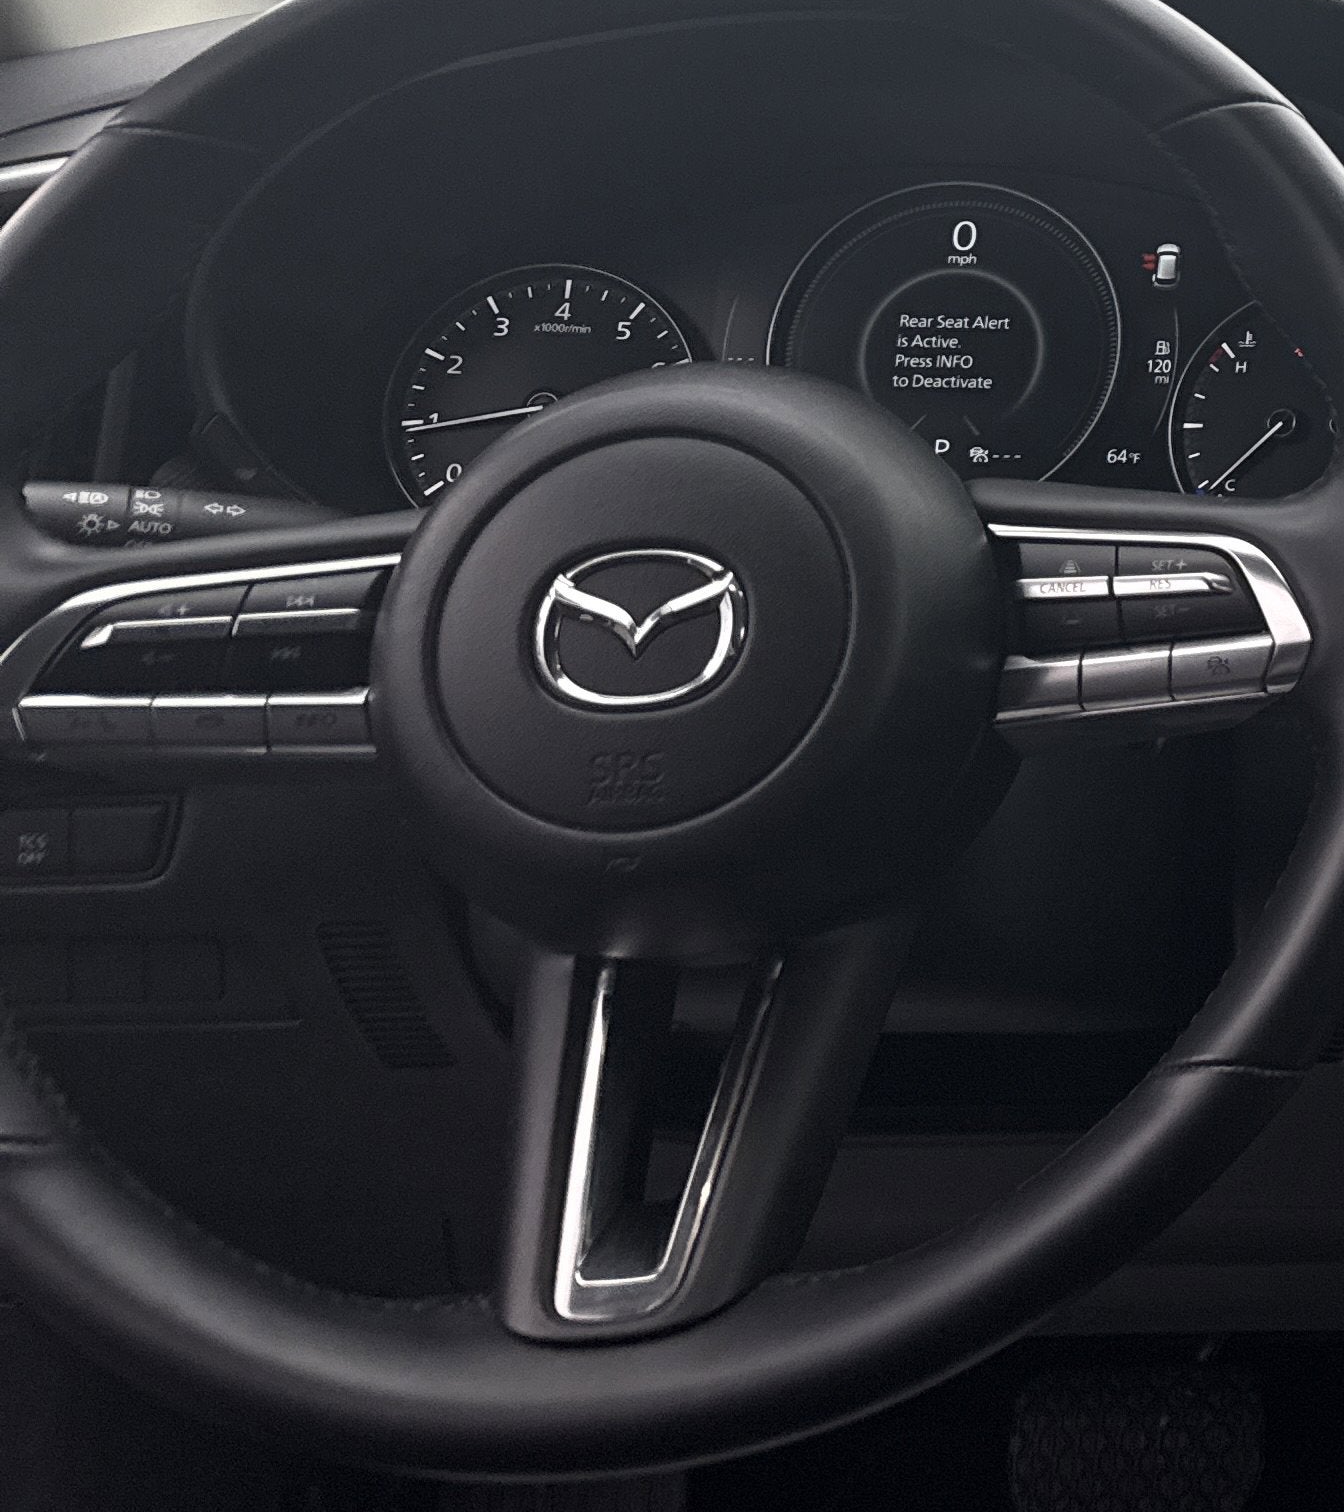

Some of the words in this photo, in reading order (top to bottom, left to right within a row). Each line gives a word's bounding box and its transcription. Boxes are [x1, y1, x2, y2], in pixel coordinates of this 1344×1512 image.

[952, 220, 977, 251] 0
[947, 253, 977, 267] mph
[554, 302, 571, 321] 4
[493, 317, 510, 336] 3
[900, 315, 933, 329] Rear
[936, 315, 970, 329] Seat
[972, 316, 1011, 330] Alert
[616, 321, 631, 340] 5
[896, 334, 908, 348] is
[911, 335, 962, 349] Active.
[446, 355, 463, 375] 2
[895, 355, 932, 369] Press
[936, 355, 973, 369] INFO
[1147, 360, 1172, 374] 120
[1235, 361, 1247, 374] H
[892, 375, 908, 388] to
[912, 375, 993, 389] Deactivate
[1154, 375, 1170, 385] mi
[446, 463, 462, 482] 0
[1225, 479, 1236, 492] C
[127, 519, 173, 534] AUTO
[1039, 581, 1087, 594] CANCEL
[1149, 579, 1171, 591] RES
